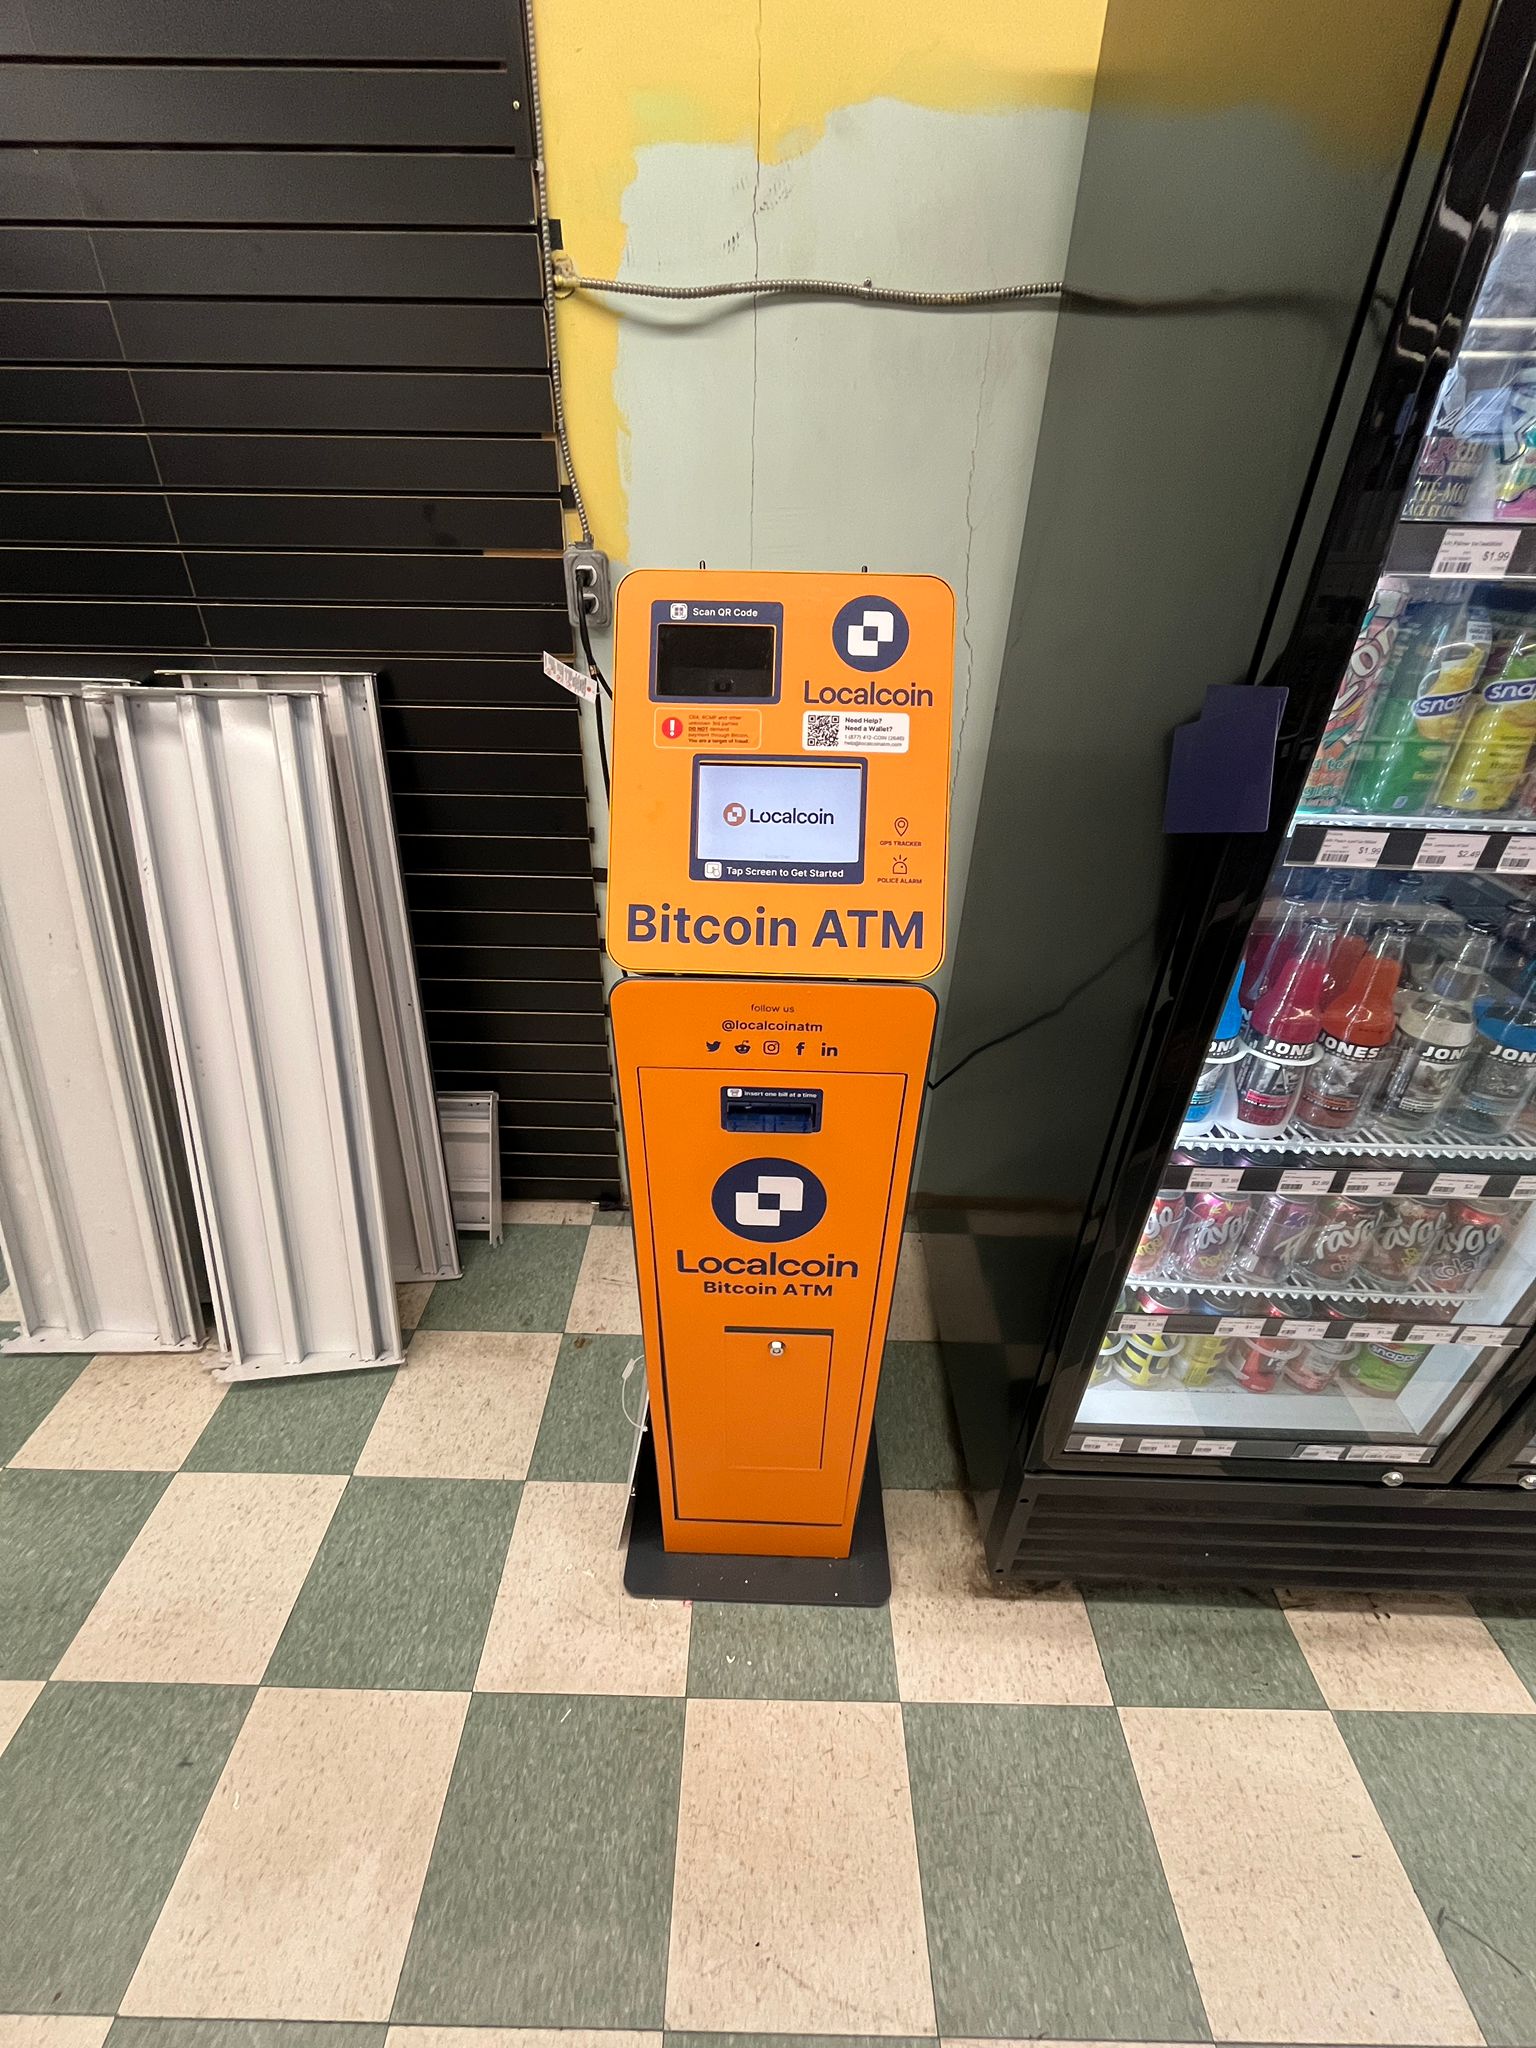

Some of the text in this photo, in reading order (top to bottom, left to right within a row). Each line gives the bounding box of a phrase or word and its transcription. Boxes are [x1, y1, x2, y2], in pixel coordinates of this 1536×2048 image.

[1482, 551, 1510, 561] $1.99
[692, 607, 758, 618] Scan QR Code
[804, 680, 933, 707] Localcoin
[749, 807, 834, 825] Localcoin
[1358, 847, 1381, 855] $1.99
[1457, 850, 1480, 858] $2.49
[726, 866, 844, 879] Tap Screen to Get Started
[627, 903, 924, 949] Bitcoin ATM
[751, 1004, 780, 1013] follow
[722, 1020, 823, 1032] @localcoinatm
[1319, 1032, 1381, 1060] JONES
[1490, 1044, 1536, 1064] JON
[1143, 1206, 1173, 1239] go
[676, 1250, 858, 1278] Localcoin
[1431, 1258, 1476, 1280] Cola
[704, 1281, 833, 1296] Bitcoin ATM
